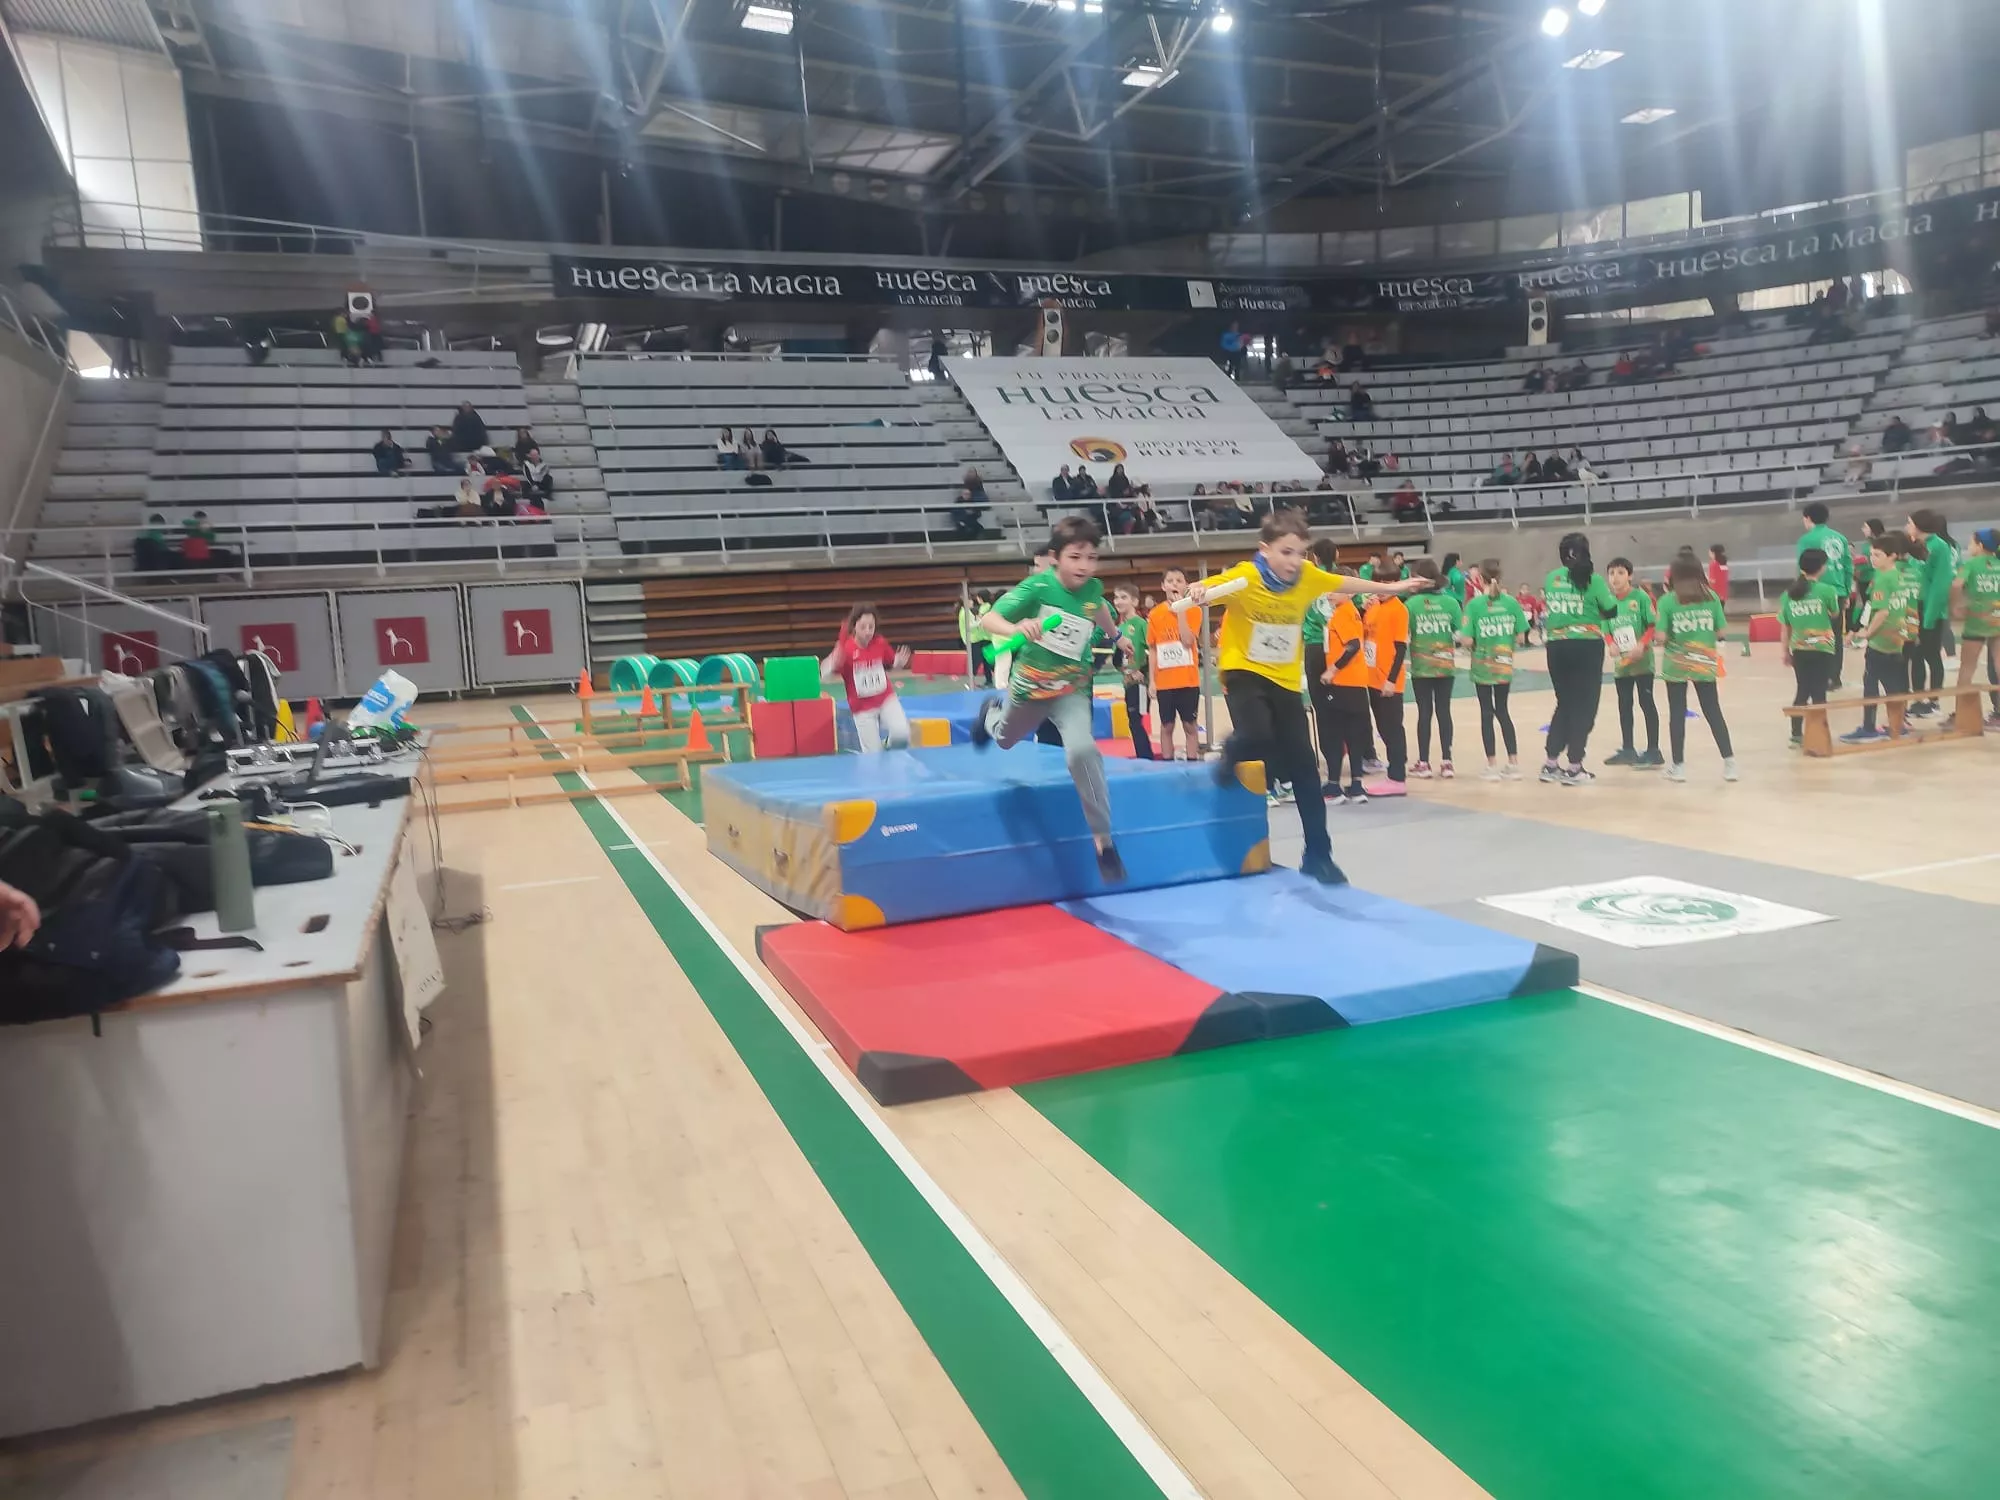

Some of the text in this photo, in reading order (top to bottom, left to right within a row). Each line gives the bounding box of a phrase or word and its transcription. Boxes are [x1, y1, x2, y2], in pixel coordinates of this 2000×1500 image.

[571, 266, 698, 292] Huesca
[875, 270, 977, 292] Huesca
[1017, 273, 1112, 296] Huesca
[1378, 276, 1475, 298] Huesca
[1239, 297, 1286, 310] Huesca
[996, 382, 1221, 405] Huesca
